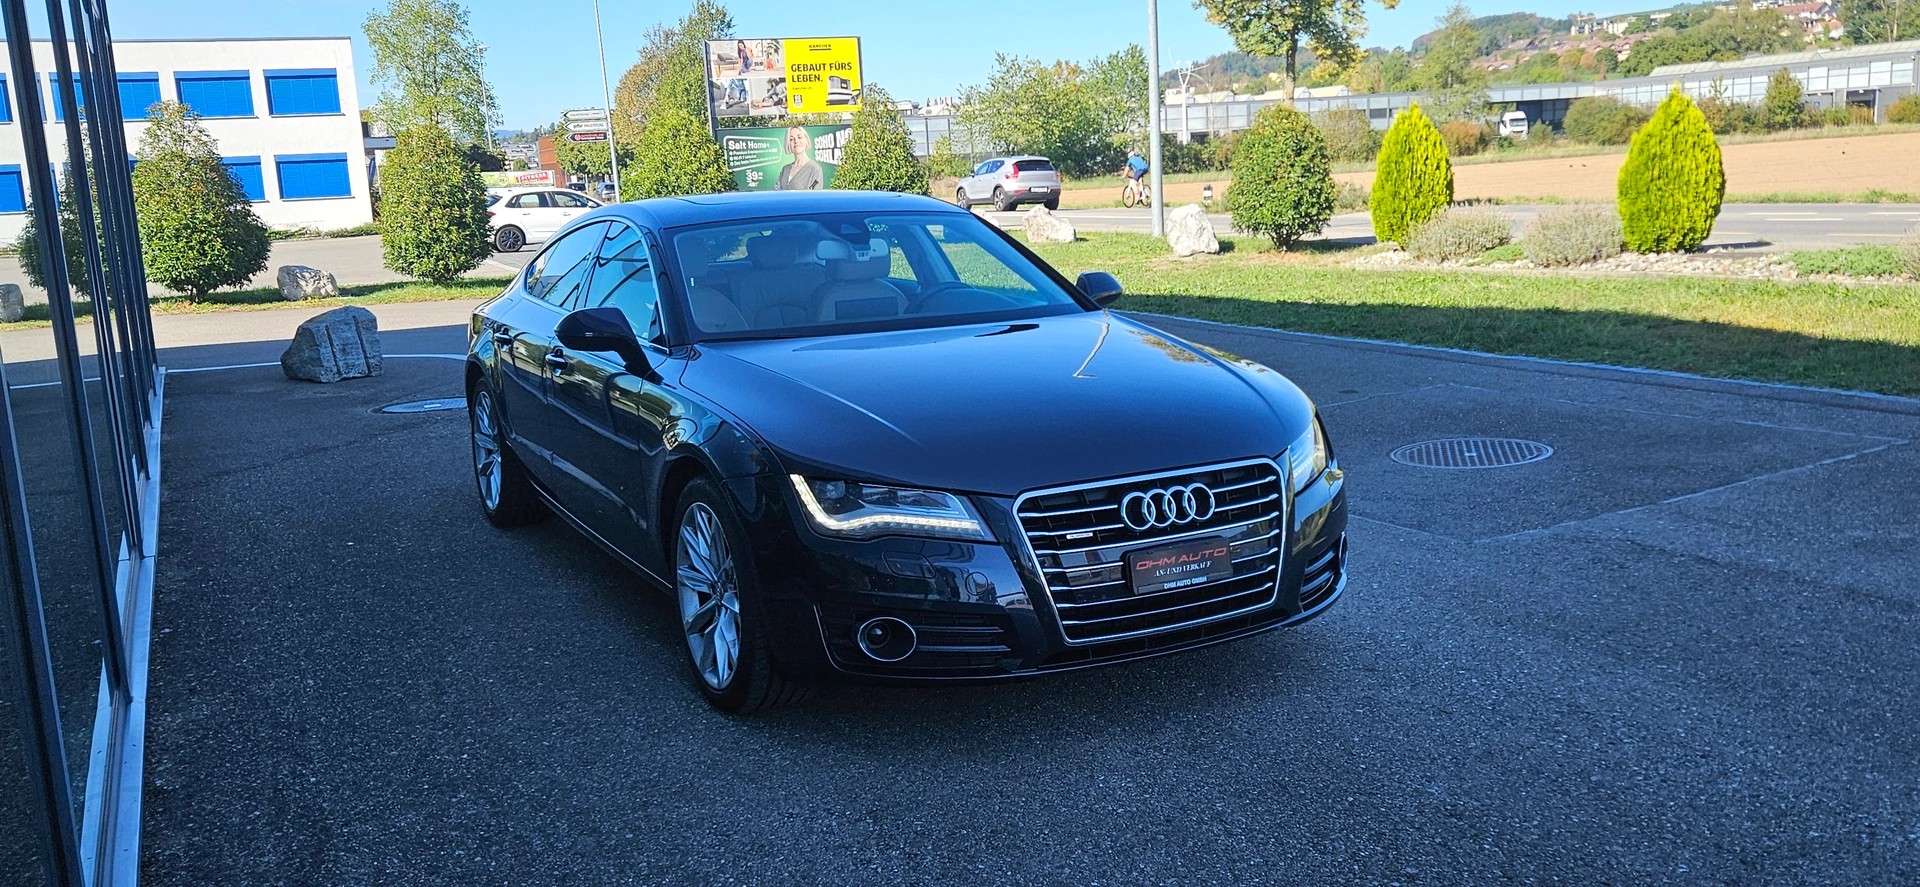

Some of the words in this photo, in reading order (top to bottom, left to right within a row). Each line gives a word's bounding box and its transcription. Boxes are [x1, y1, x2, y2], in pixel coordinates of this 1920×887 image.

[791, 63, 827, 72] GEBAUT
[829, 61, 852, 71] FÜRS
[791, 74, 823, 82] LEBEN.
[728, 140, 746, 150] Salt
[1177, 547, 1228, 562] AUTO
[1182, 560, 1212, 572] VERKAUF
[1177, 579, 1191, 587] AUTO
